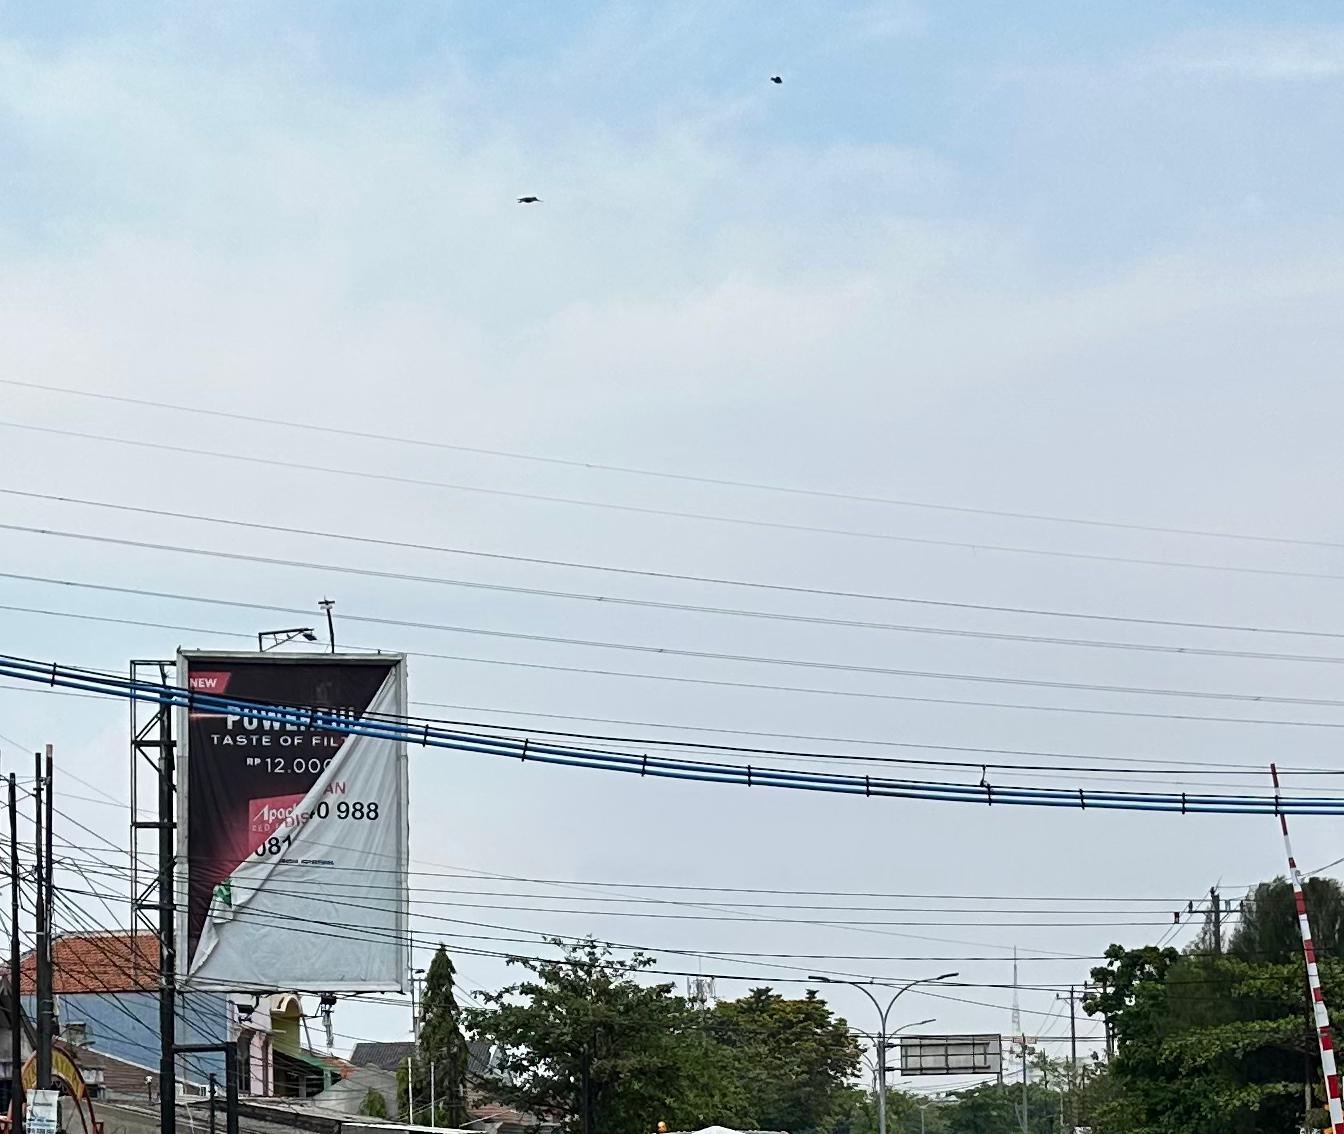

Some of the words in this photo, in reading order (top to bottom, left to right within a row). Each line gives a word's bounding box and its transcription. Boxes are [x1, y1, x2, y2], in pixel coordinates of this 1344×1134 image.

[189, 678, 217, 688] NEW
[211, 734, 272, 746] TASTE
[280, 736, 303, 746] OF
[247, 757, 261, 766] RP
[336, 801, 379, 820] 988
